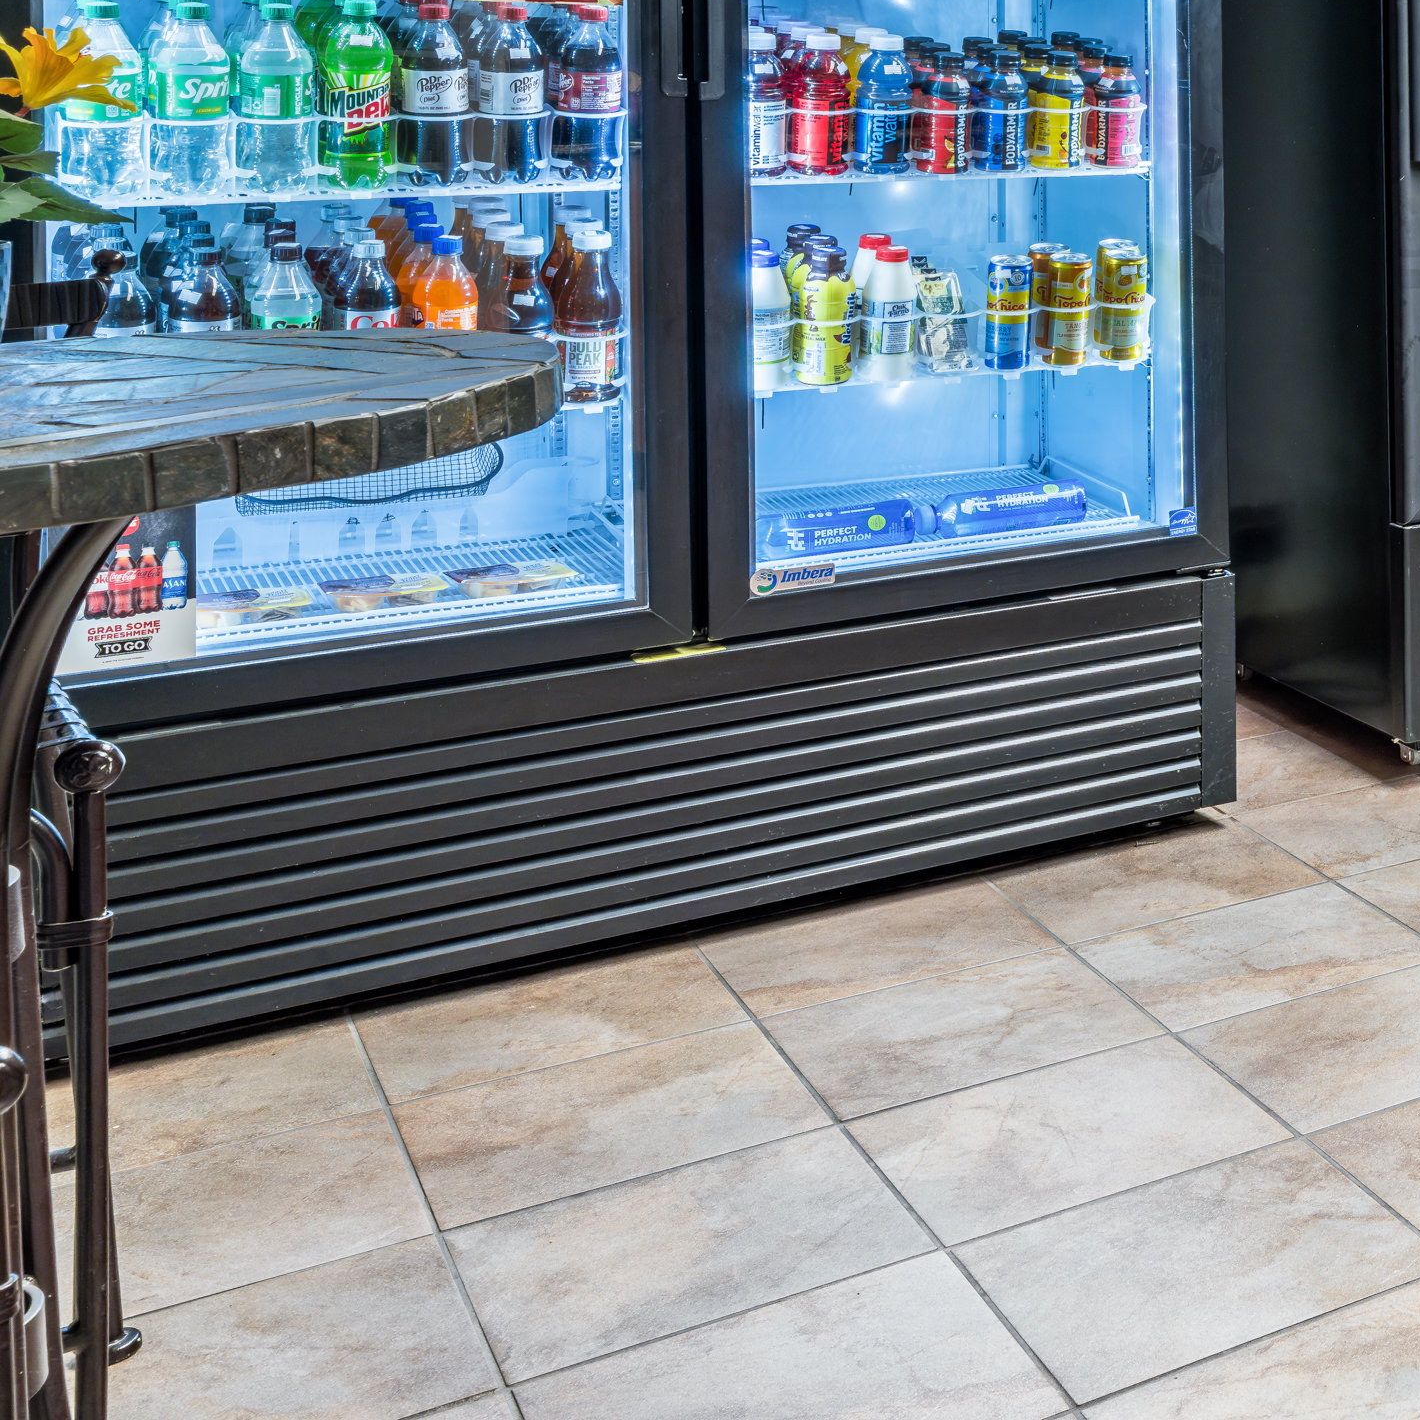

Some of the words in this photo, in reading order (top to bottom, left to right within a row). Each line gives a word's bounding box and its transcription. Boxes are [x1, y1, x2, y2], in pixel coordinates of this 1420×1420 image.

[417, 77, 452, 92] Pepper
[428, 75, 442, 85] Dr
[522, 76, 535, 86] Dr
[422, 95, 437, 103] Diet
[515, 96, 529, 104] Diet
[891, 303, 907, 312] Oak
[995, 299, 1025, 311] Chico
[1053, 294, 1086, 309] Topo
[887, 308, 910, 318] Farms
[568, 352, 601, 366] PEAK
[996, 490, 1035, 501] PERFECT
[997, 495, 1049, 507] HYDRATION
[814, 525, 857, 539] PERFECT
[814, 532, 872, 547] HYDRATION
[780, 566, 834, 583] Imbera
[88, 624, 123, 635] GRAB
[126, 619, 161, 631] SOME
[87, 627, 161, 642] REFRESHMENT
[102, 643, 122, 654] TO
[124, 640, 146, 651] GO
